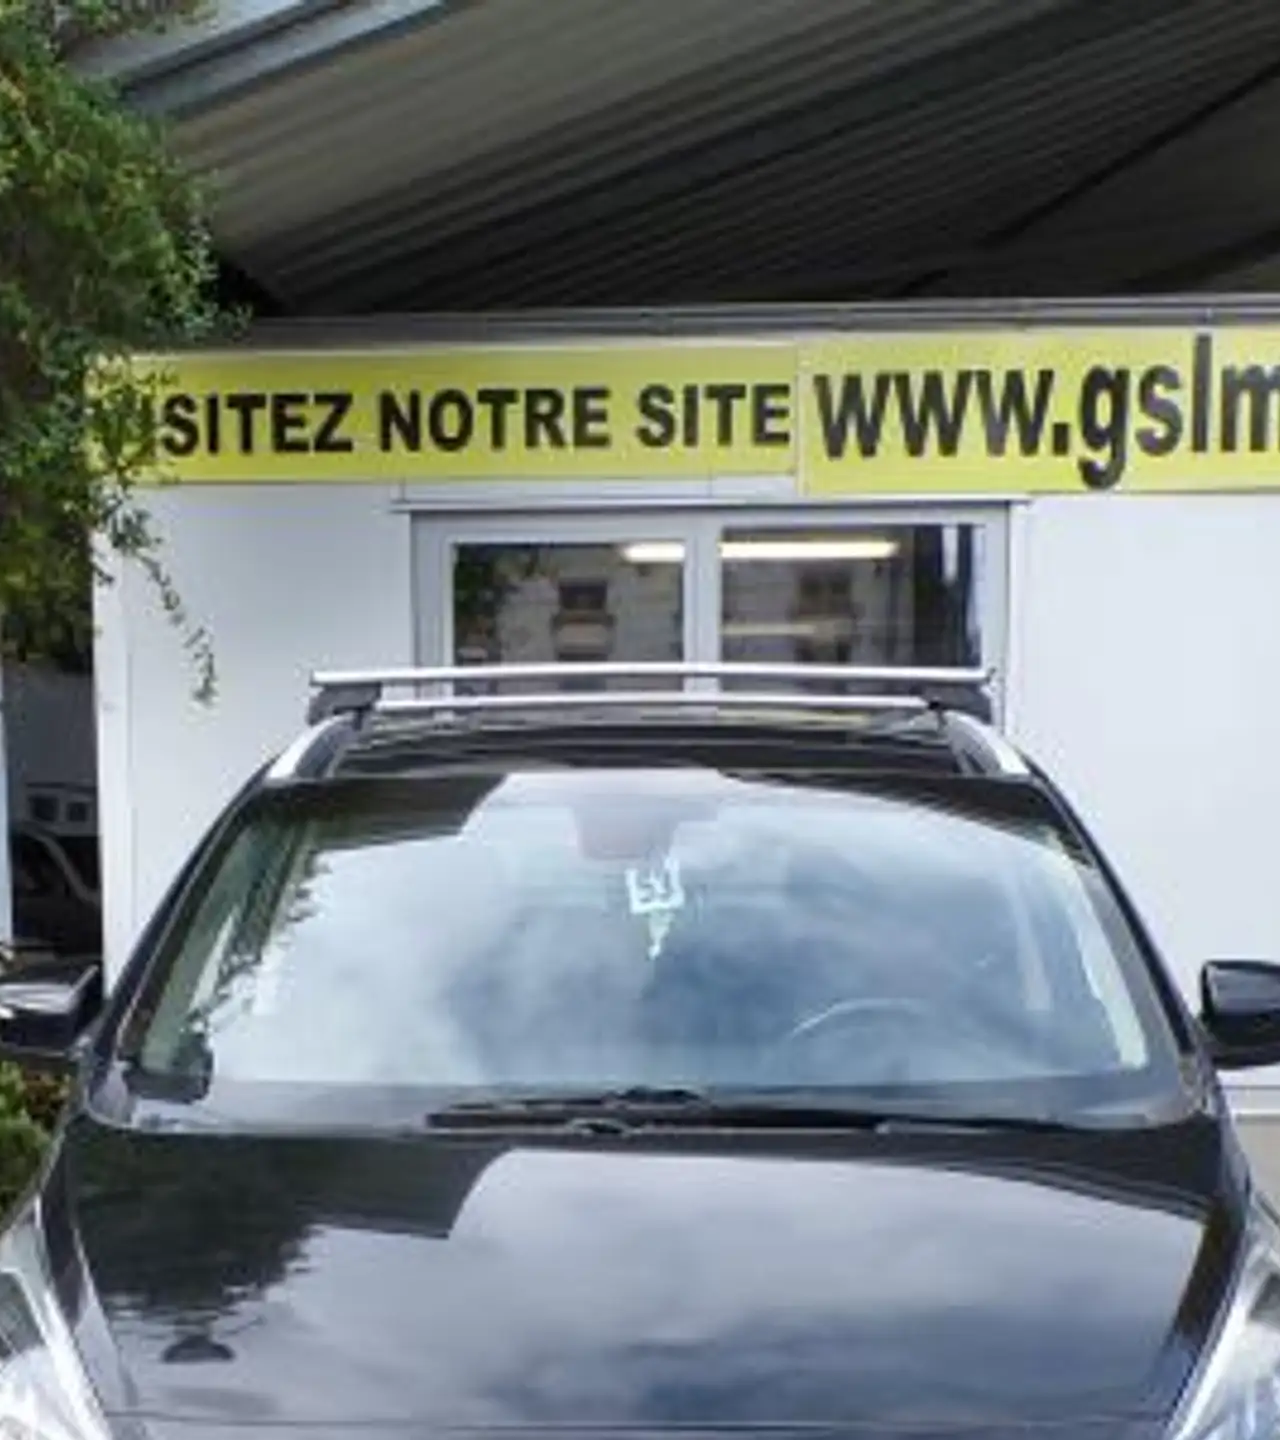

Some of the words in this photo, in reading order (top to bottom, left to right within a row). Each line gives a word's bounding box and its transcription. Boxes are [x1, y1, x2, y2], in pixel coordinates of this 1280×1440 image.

[140, 391, 354, 457] SITEZ
[378, 387, 610, 452] NOTRE
[636, 383, 791, 448] SITE
